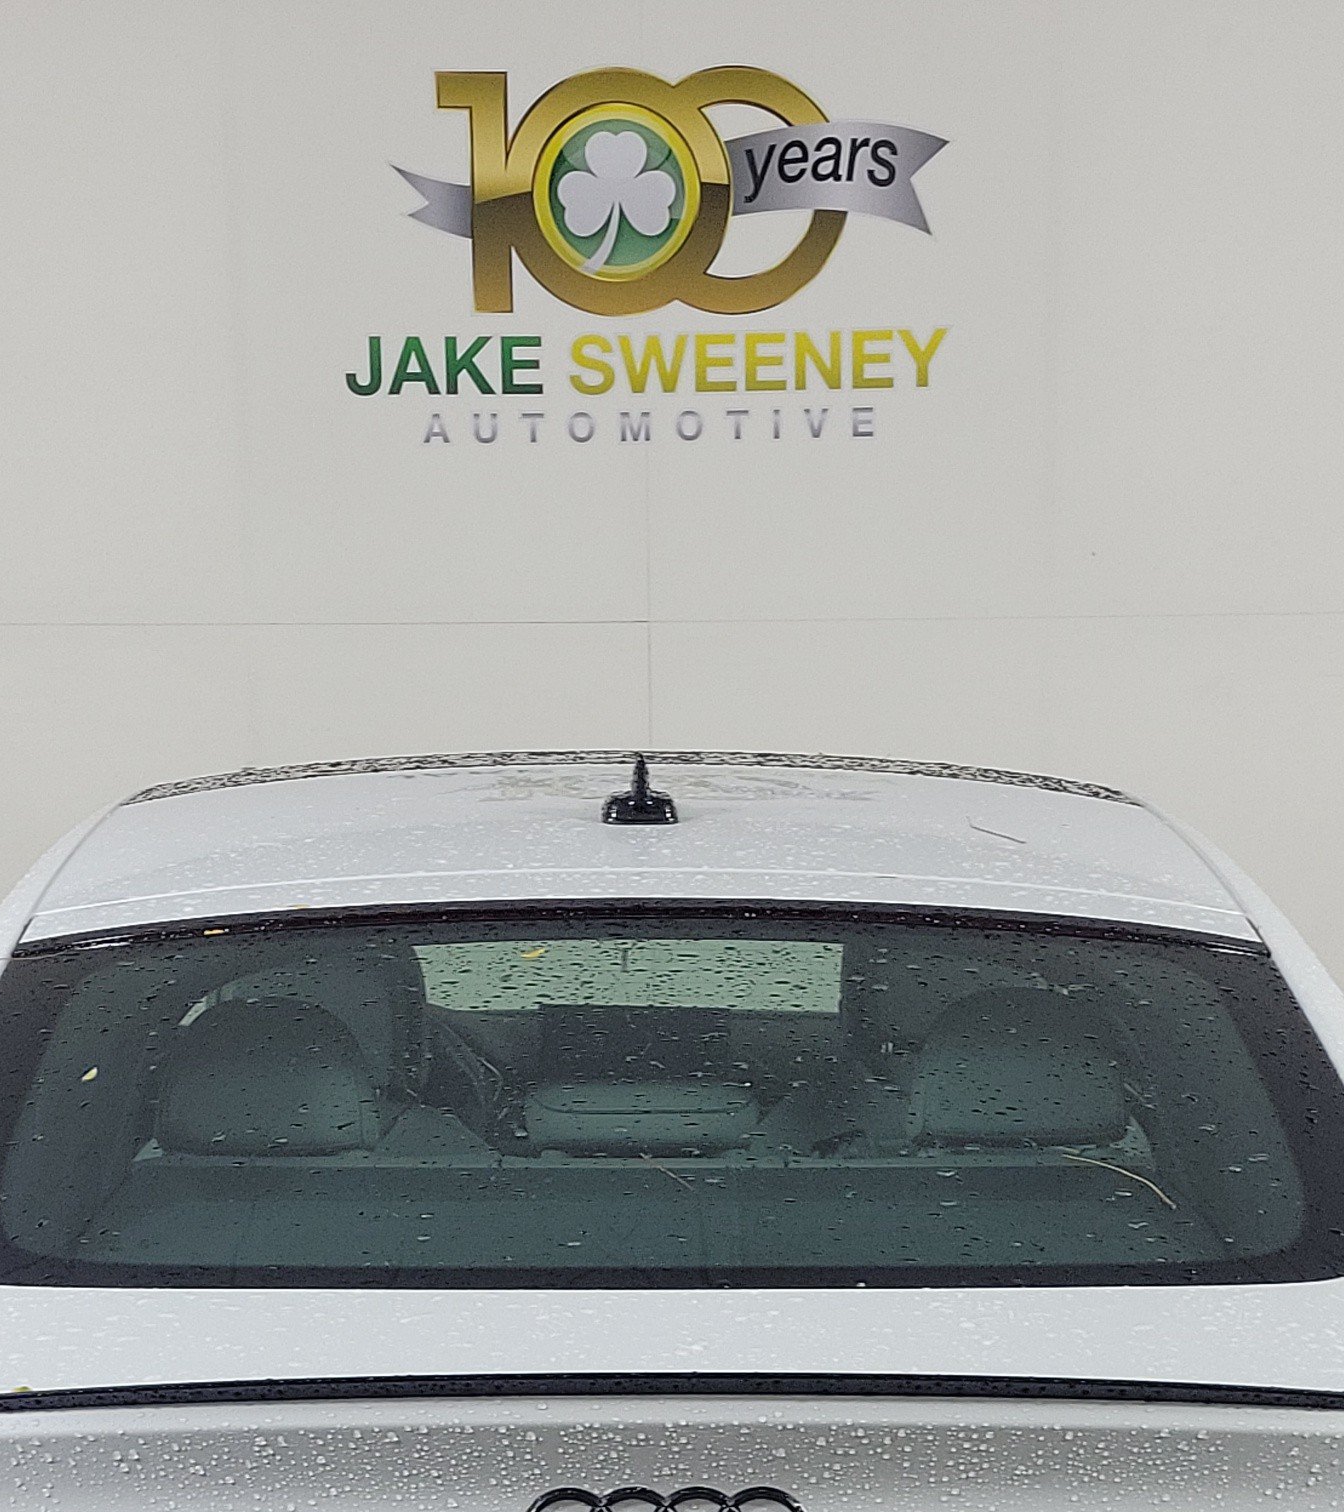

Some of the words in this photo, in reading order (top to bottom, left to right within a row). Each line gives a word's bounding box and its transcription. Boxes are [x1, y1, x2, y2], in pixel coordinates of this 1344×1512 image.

[436, 65, 848, 316] 100
[743, 135, 899, 203] years
[345, 335, 544, 396] JAKE
[568, 327, 948, 396] SWEENEY
[422, 406, 876, 445] AUTOMOTIVE
